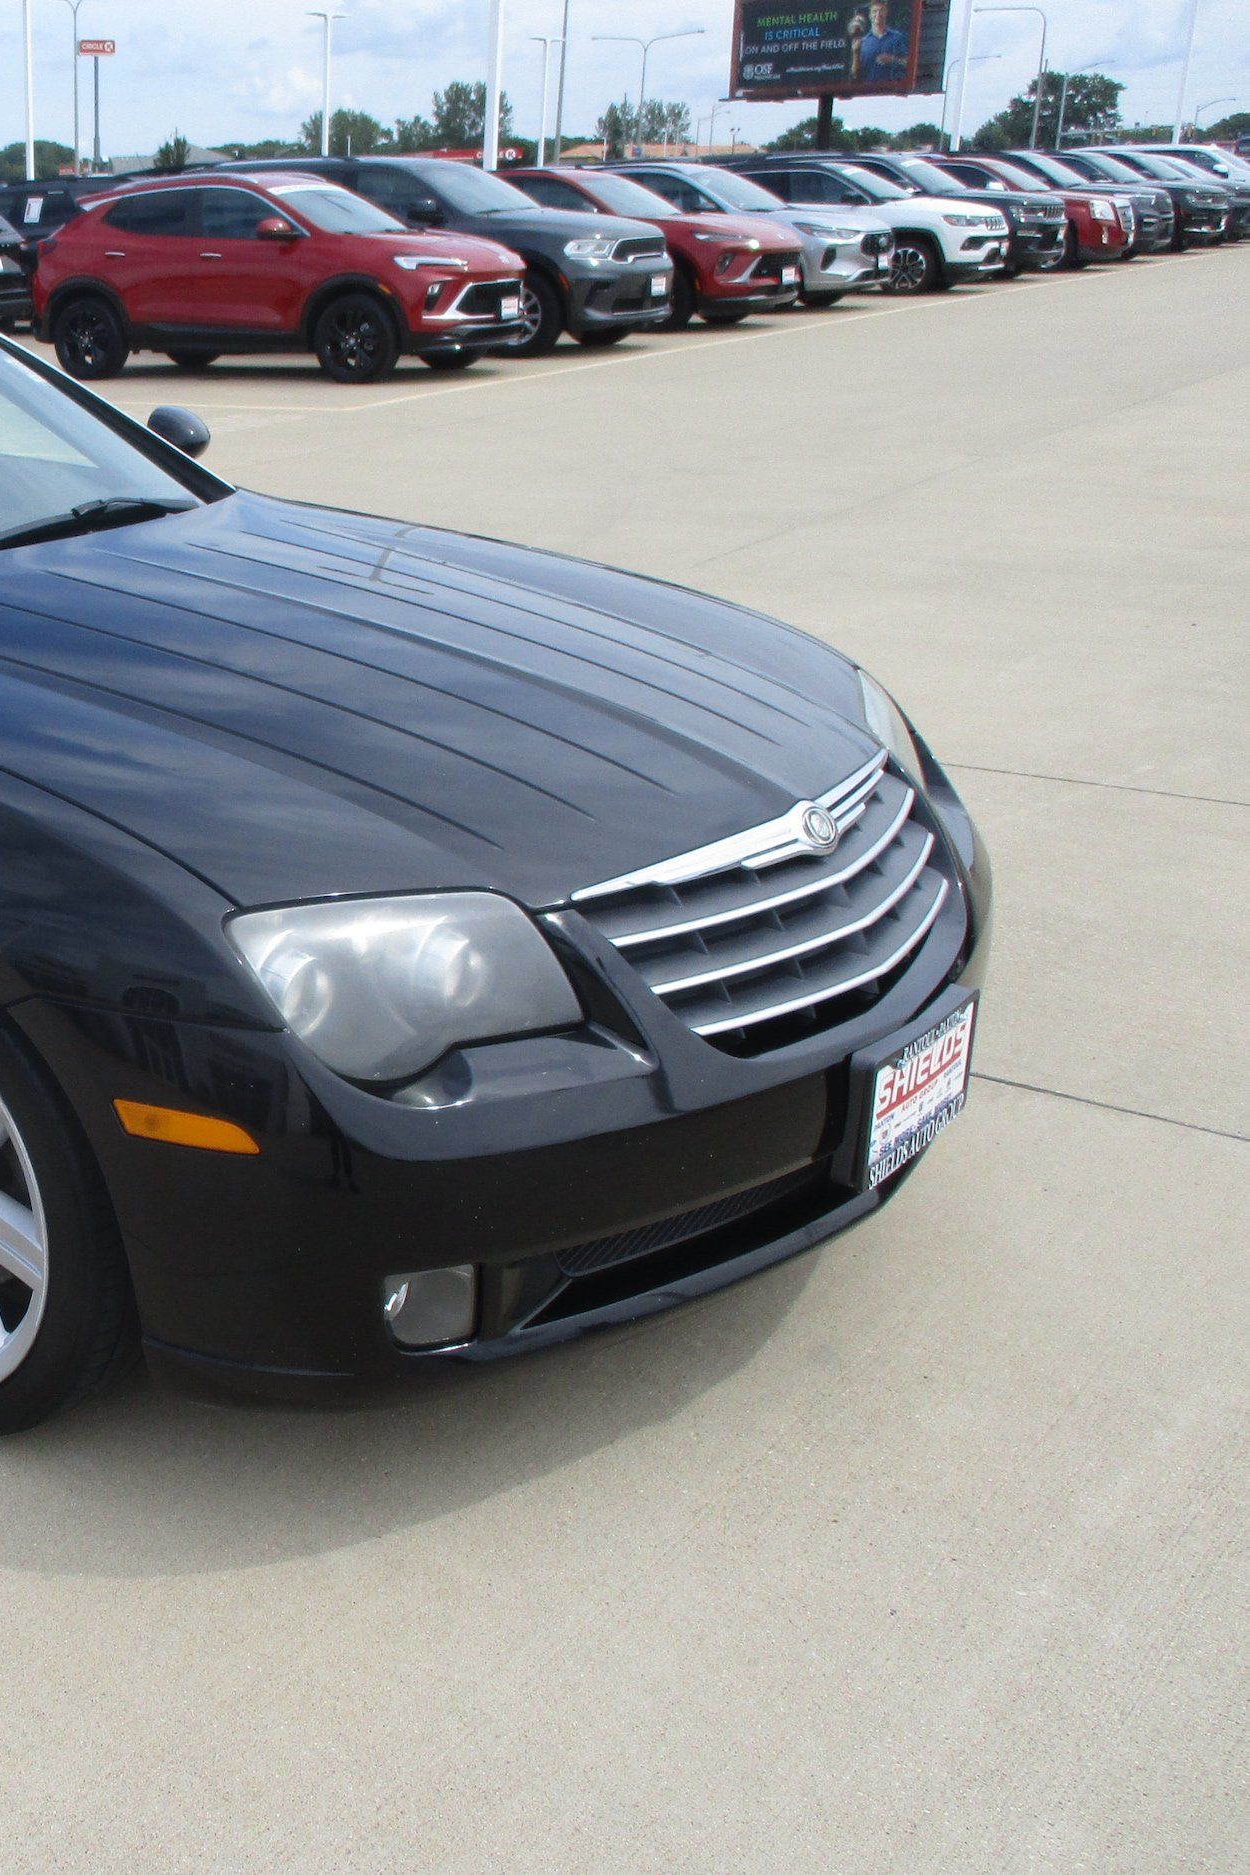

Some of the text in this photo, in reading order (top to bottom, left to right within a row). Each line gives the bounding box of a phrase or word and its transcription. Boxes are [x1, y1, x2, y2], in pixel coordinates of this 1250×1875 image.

[757, 11, 838, 27] MENTAL HEALTH
[764, 27, 821, 41] IS CRITICAL
[745, 45, 759, 55] ON
[760, 44, 780, 54] AND
[781, 42, 799, 53] OFF
[801, 41, 818, 51] THE
[754, 63, 773, 75] OSF
[878, 1023, 966, 1111] SHIELDS
[868, 1093, 964, 1190] SHIELDS AUTO GROUP
